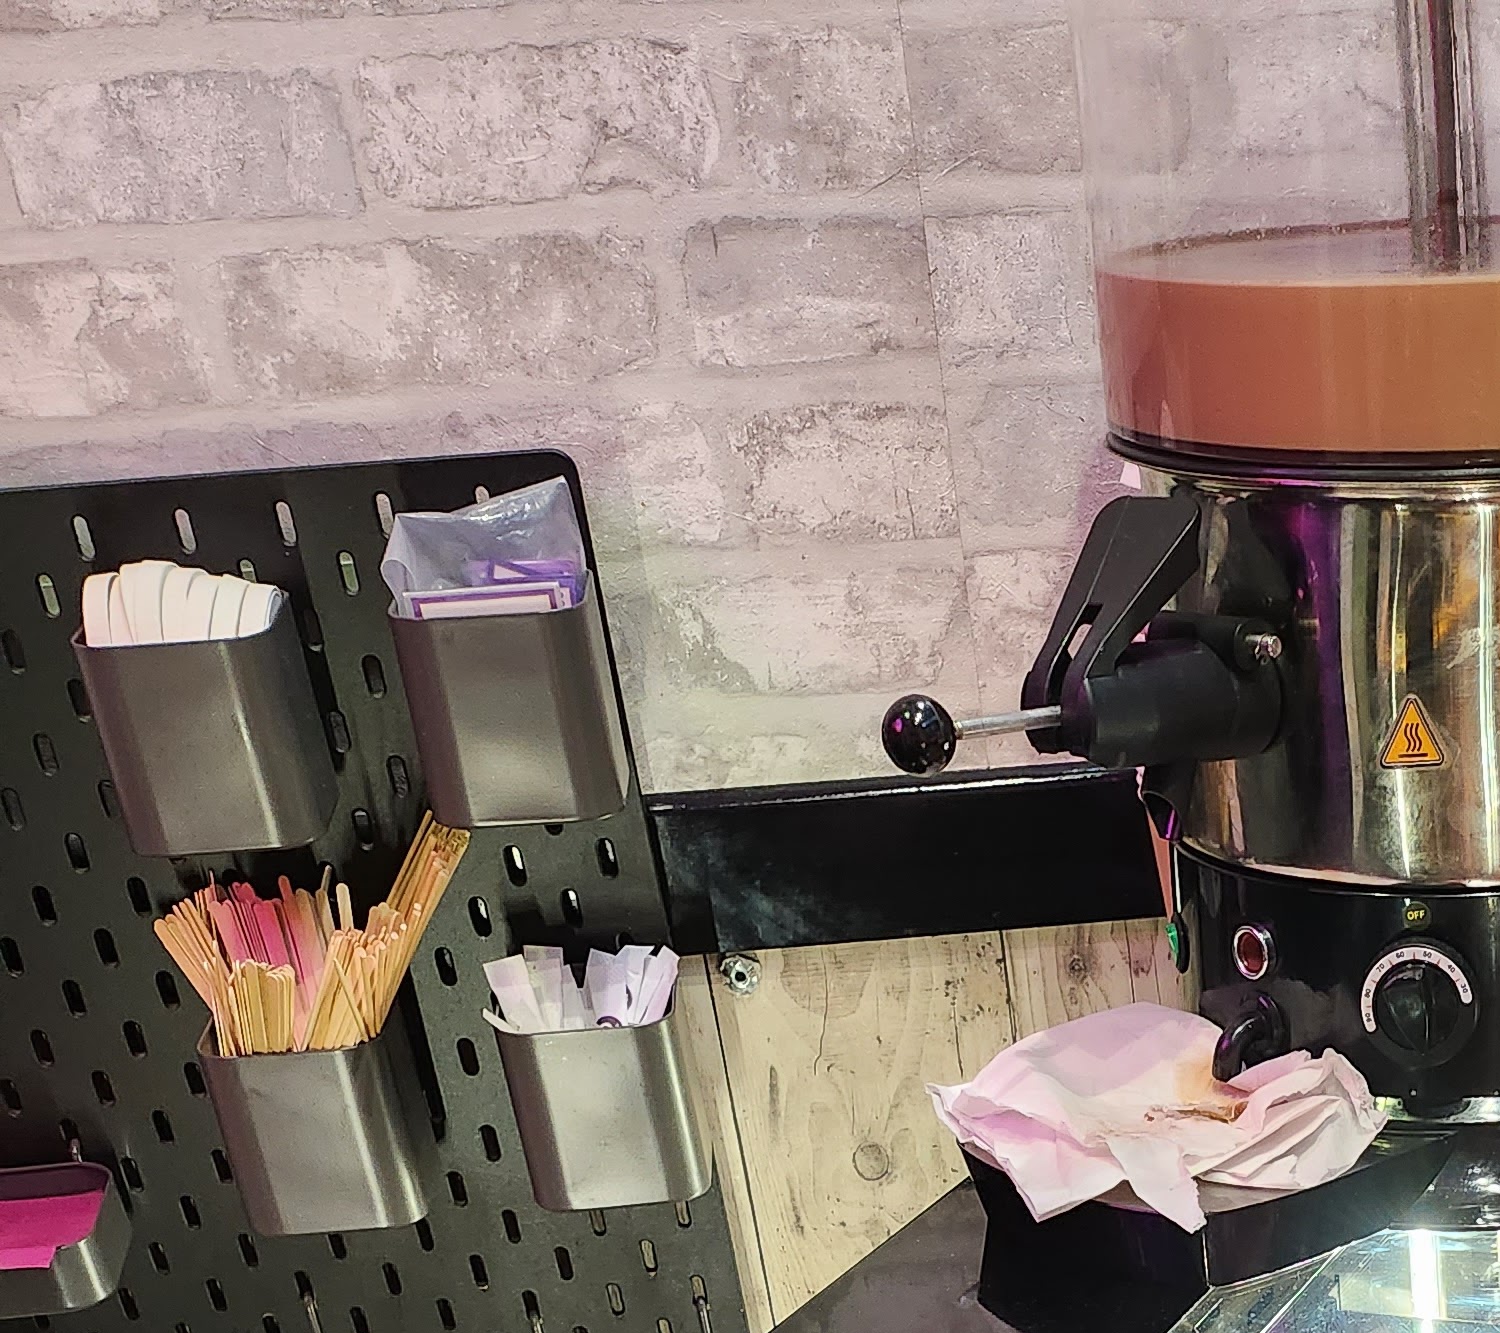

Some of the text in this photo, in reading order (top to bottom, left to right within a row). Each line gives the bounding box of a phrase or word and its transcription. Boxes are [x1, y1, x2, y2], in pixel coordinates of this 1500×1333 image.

[1407, 909, 1425, 920] OFF
[1376, 963, 1385, 972] 70
[1447, 964, 1456, 973] 40
[1364, 988, 1371, 998] 80
[1460, 984, 1468, 993] 30
